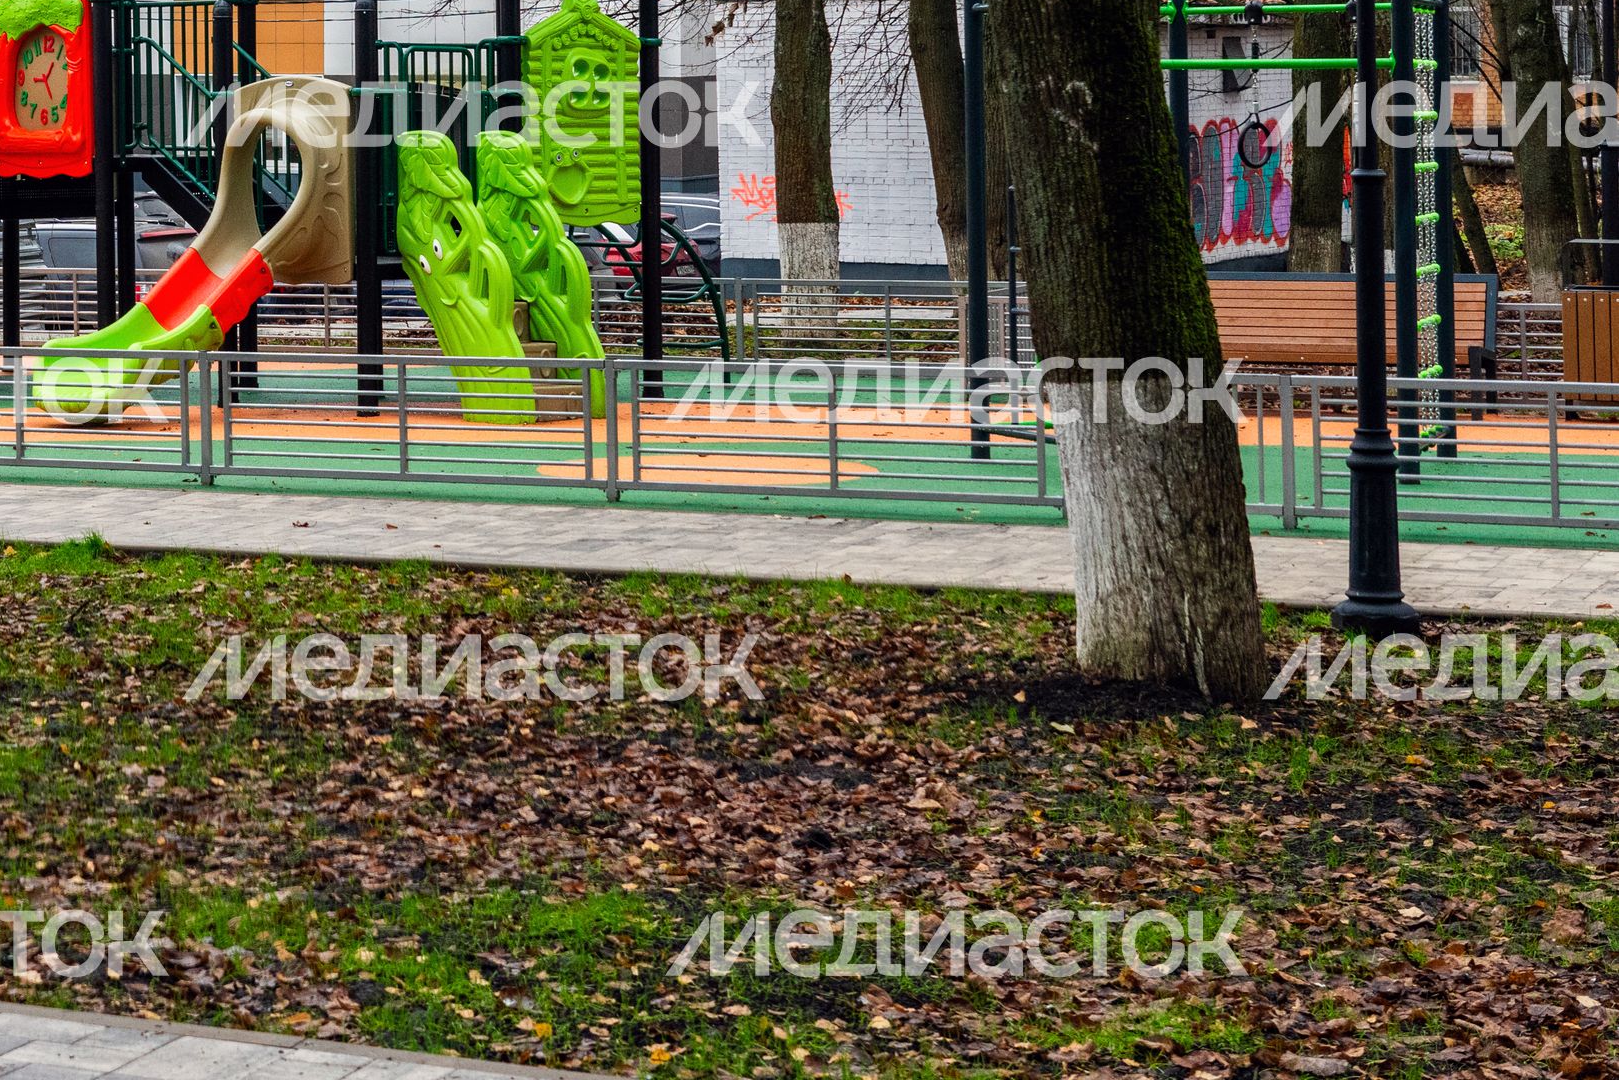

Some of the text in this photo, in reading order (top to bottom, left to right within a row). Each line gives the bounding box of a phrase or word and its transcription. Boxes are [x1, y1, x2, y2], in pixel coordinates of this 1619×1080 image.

[44, 35, 55, 53] 12
[23, 48, 33, 69] 10
[20, 91, 28, 107] 8
[30, 103, 38, 119] 7
[40, 108, 49, 125] 6
[51, 106, 59, 123] 5
